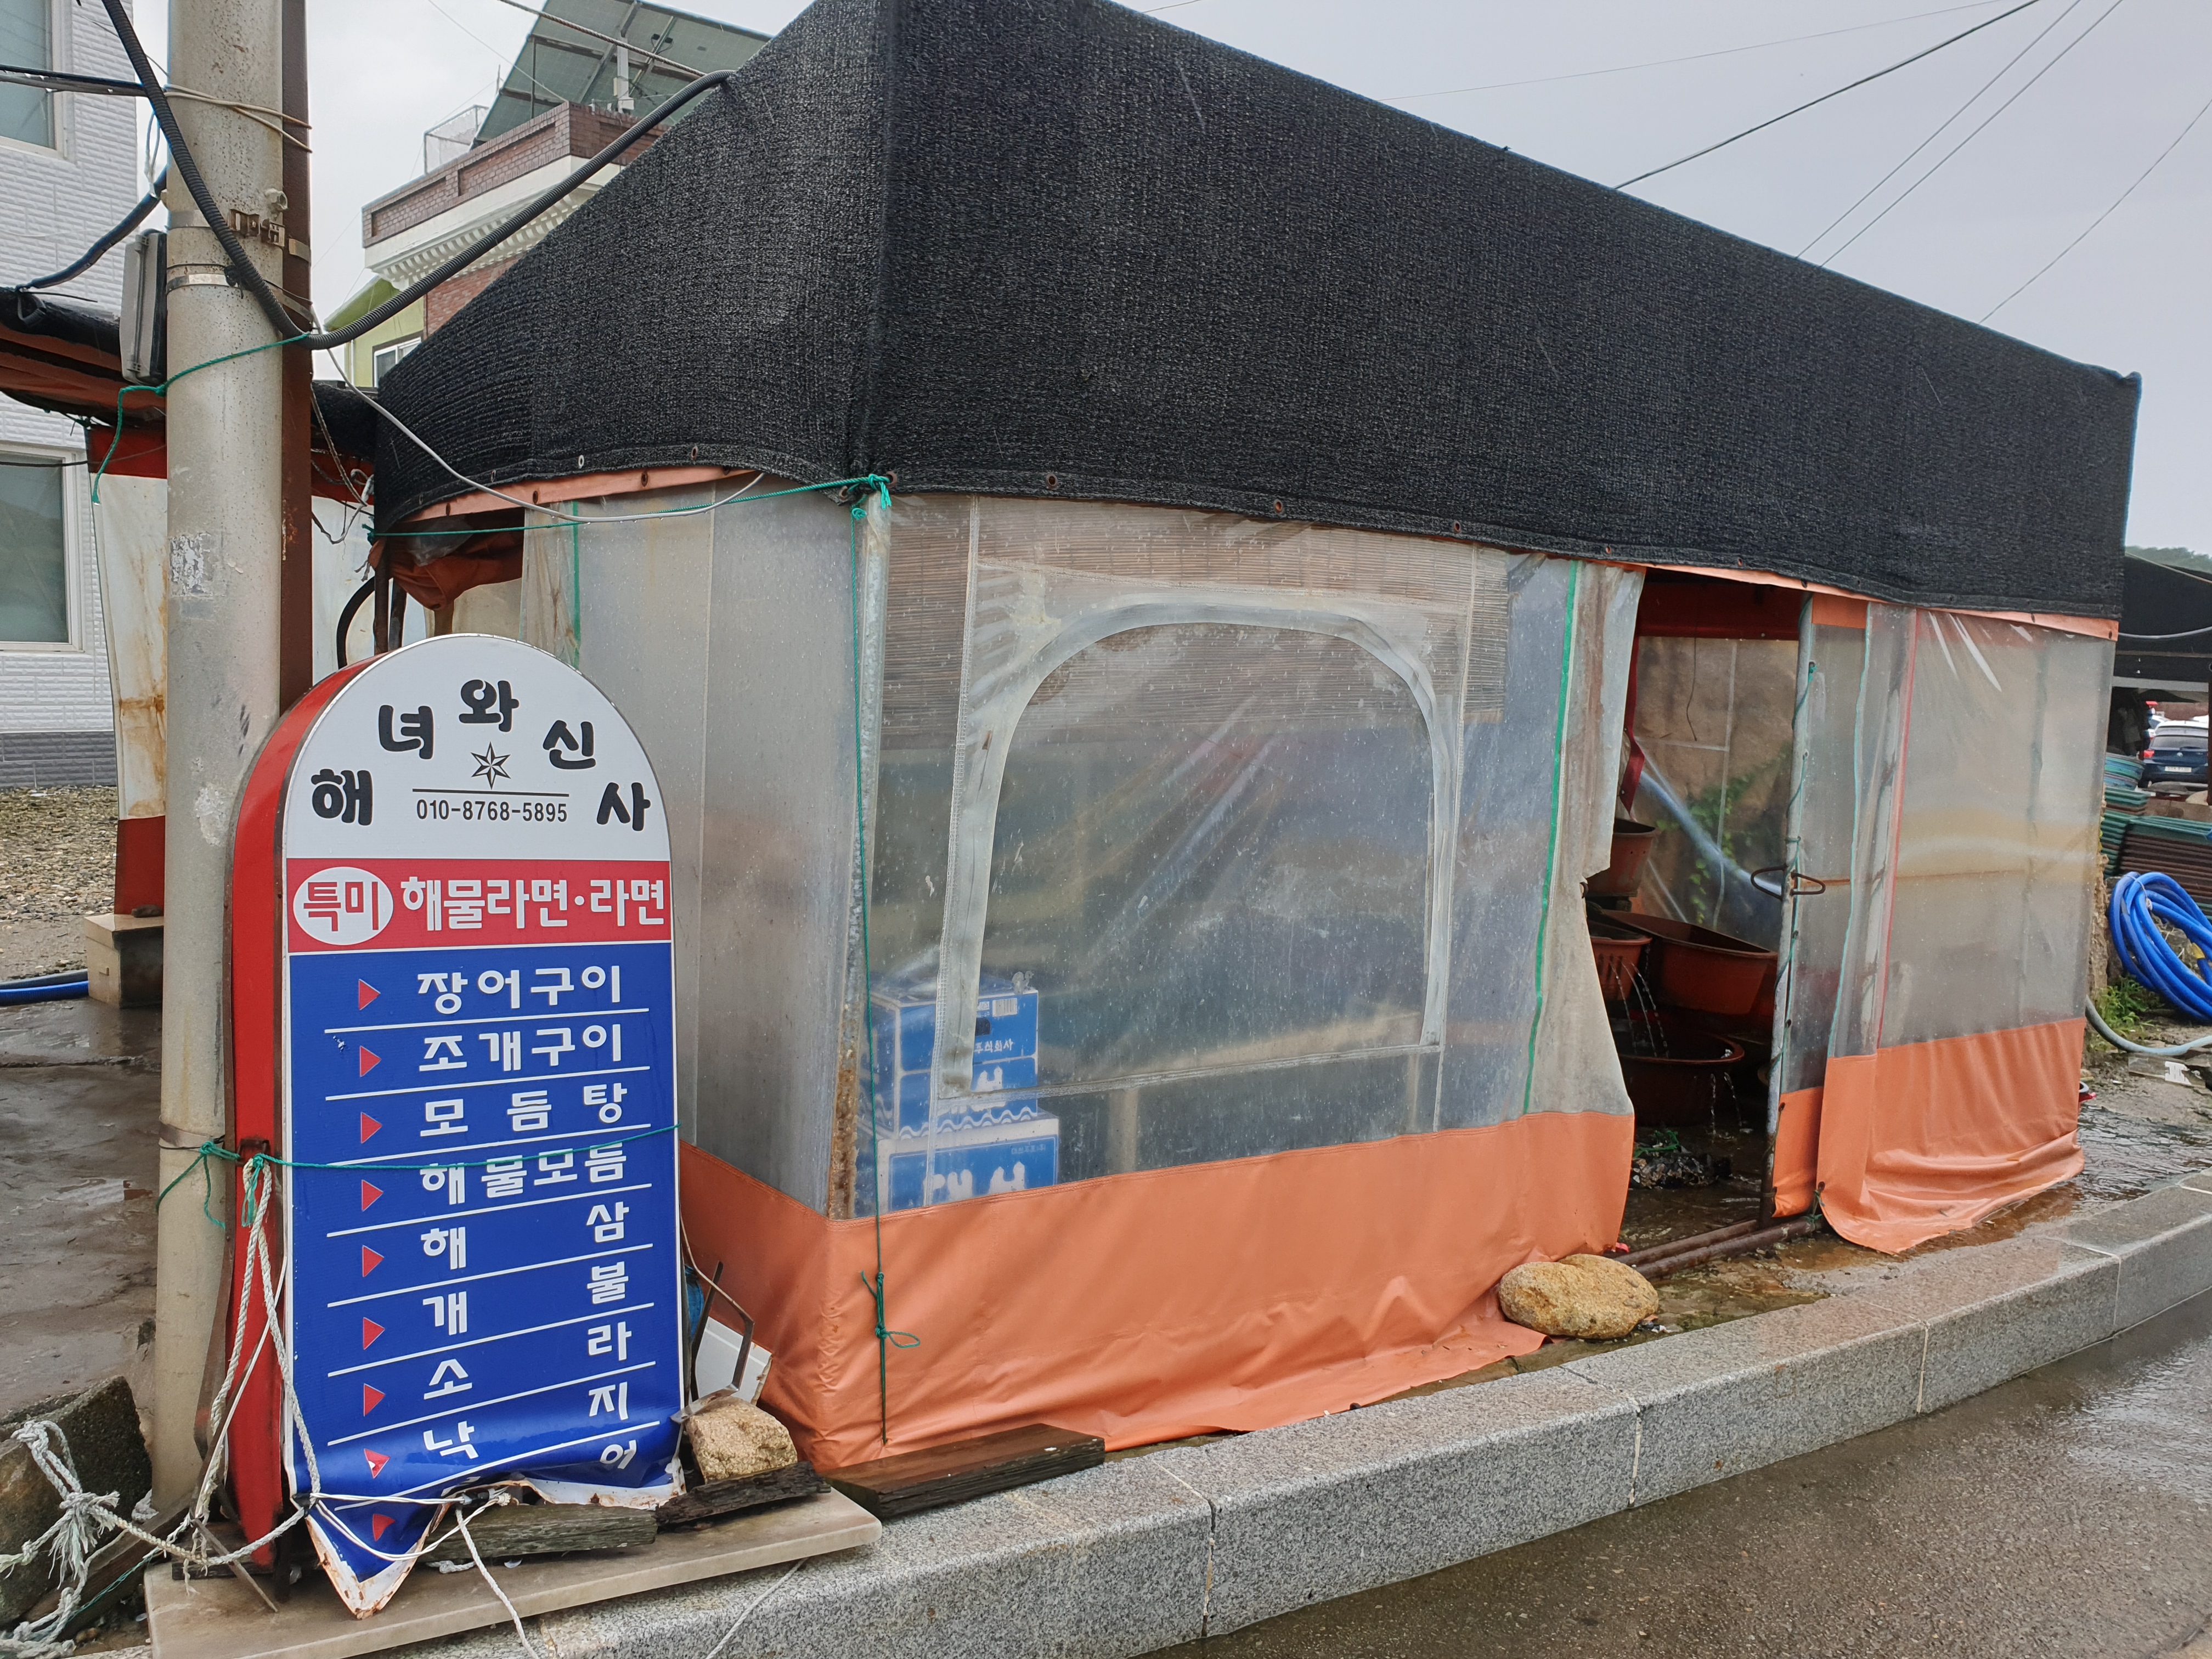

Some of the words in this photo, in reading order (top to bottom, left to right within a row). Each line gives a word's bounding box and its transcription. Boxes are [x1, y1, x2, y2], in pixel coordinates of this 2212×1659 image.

[416, 799, 568, 823] 010-8768-5895
[303, 881, 380, 932] 특미
[417, 965, 620, 1014] 장어구이
[419, 1023, 622, 1072] 조개구이
[974, 1038, 1014, 1054] 주식회사
[420, 1142, 627, 1205] 해물모듬
